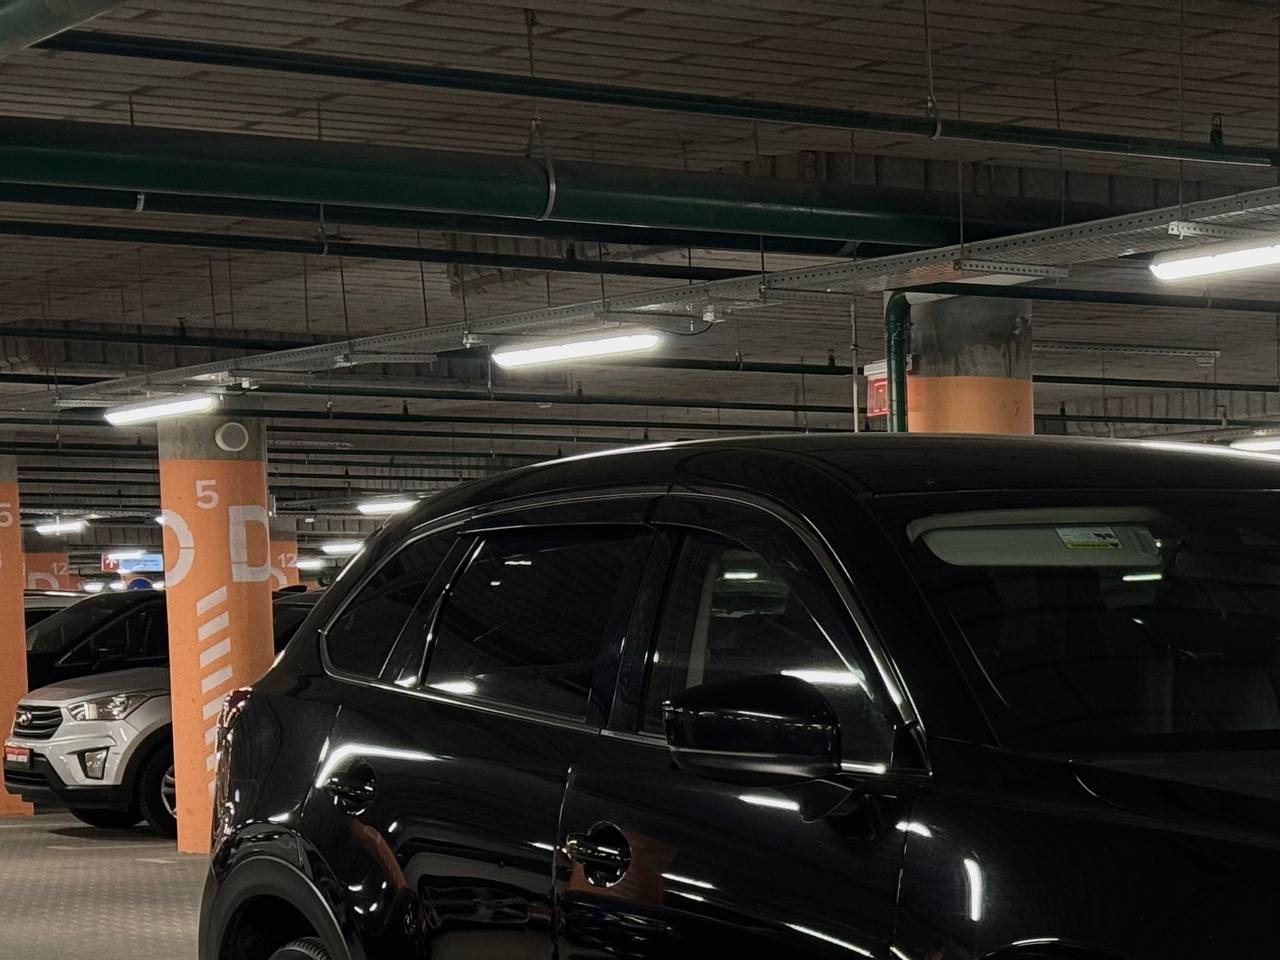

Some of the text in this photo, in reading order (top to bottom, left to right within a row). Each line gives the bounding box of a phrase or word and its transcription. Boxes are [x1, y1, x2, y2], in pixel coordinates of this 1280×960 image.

[196, 480, 219, 509] 5
[229, 505, 270, 582] D
[50, 562, 69, 576] 12
[278, 553, 298, 568] 12
